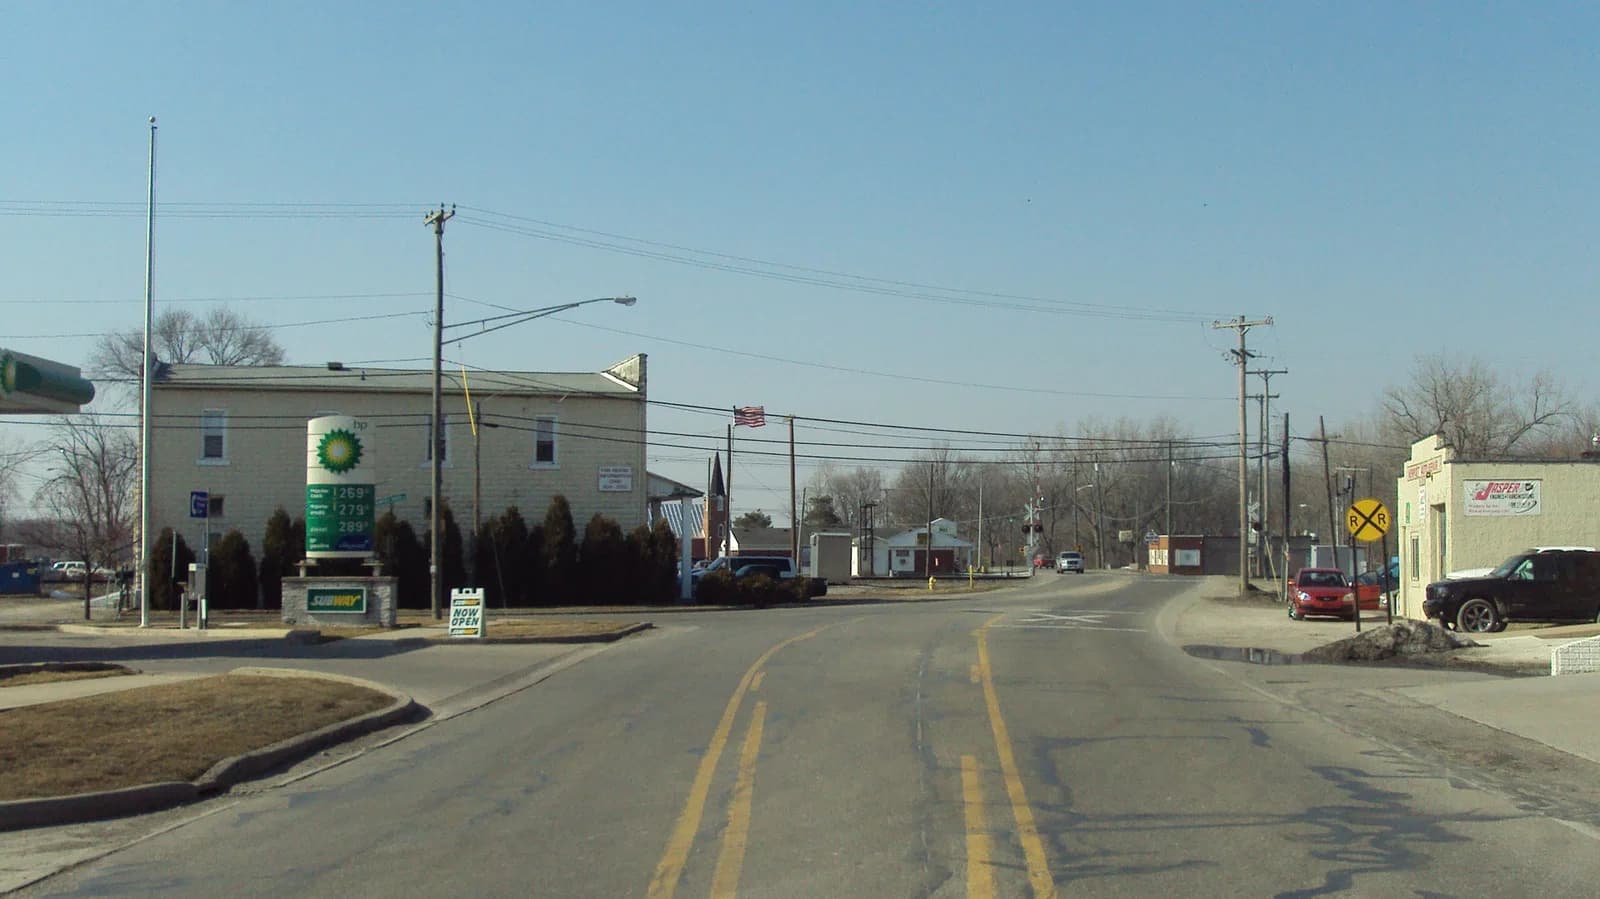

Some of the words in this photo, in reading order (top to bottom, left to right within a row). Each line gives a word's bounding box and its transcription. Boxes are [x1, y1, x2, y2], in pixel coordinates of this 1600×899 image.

[353, 419, 368, 431] bp
[1475, 482, 1520, 500] JASPER
[1350, 516, 1358, 527] R
[1378, 513, 1386, 525] R
[310, 595, 361, 607] SUBWAY
[453, 608, 478, 617] NOW
[451, 617, 479, 626] OPEN
